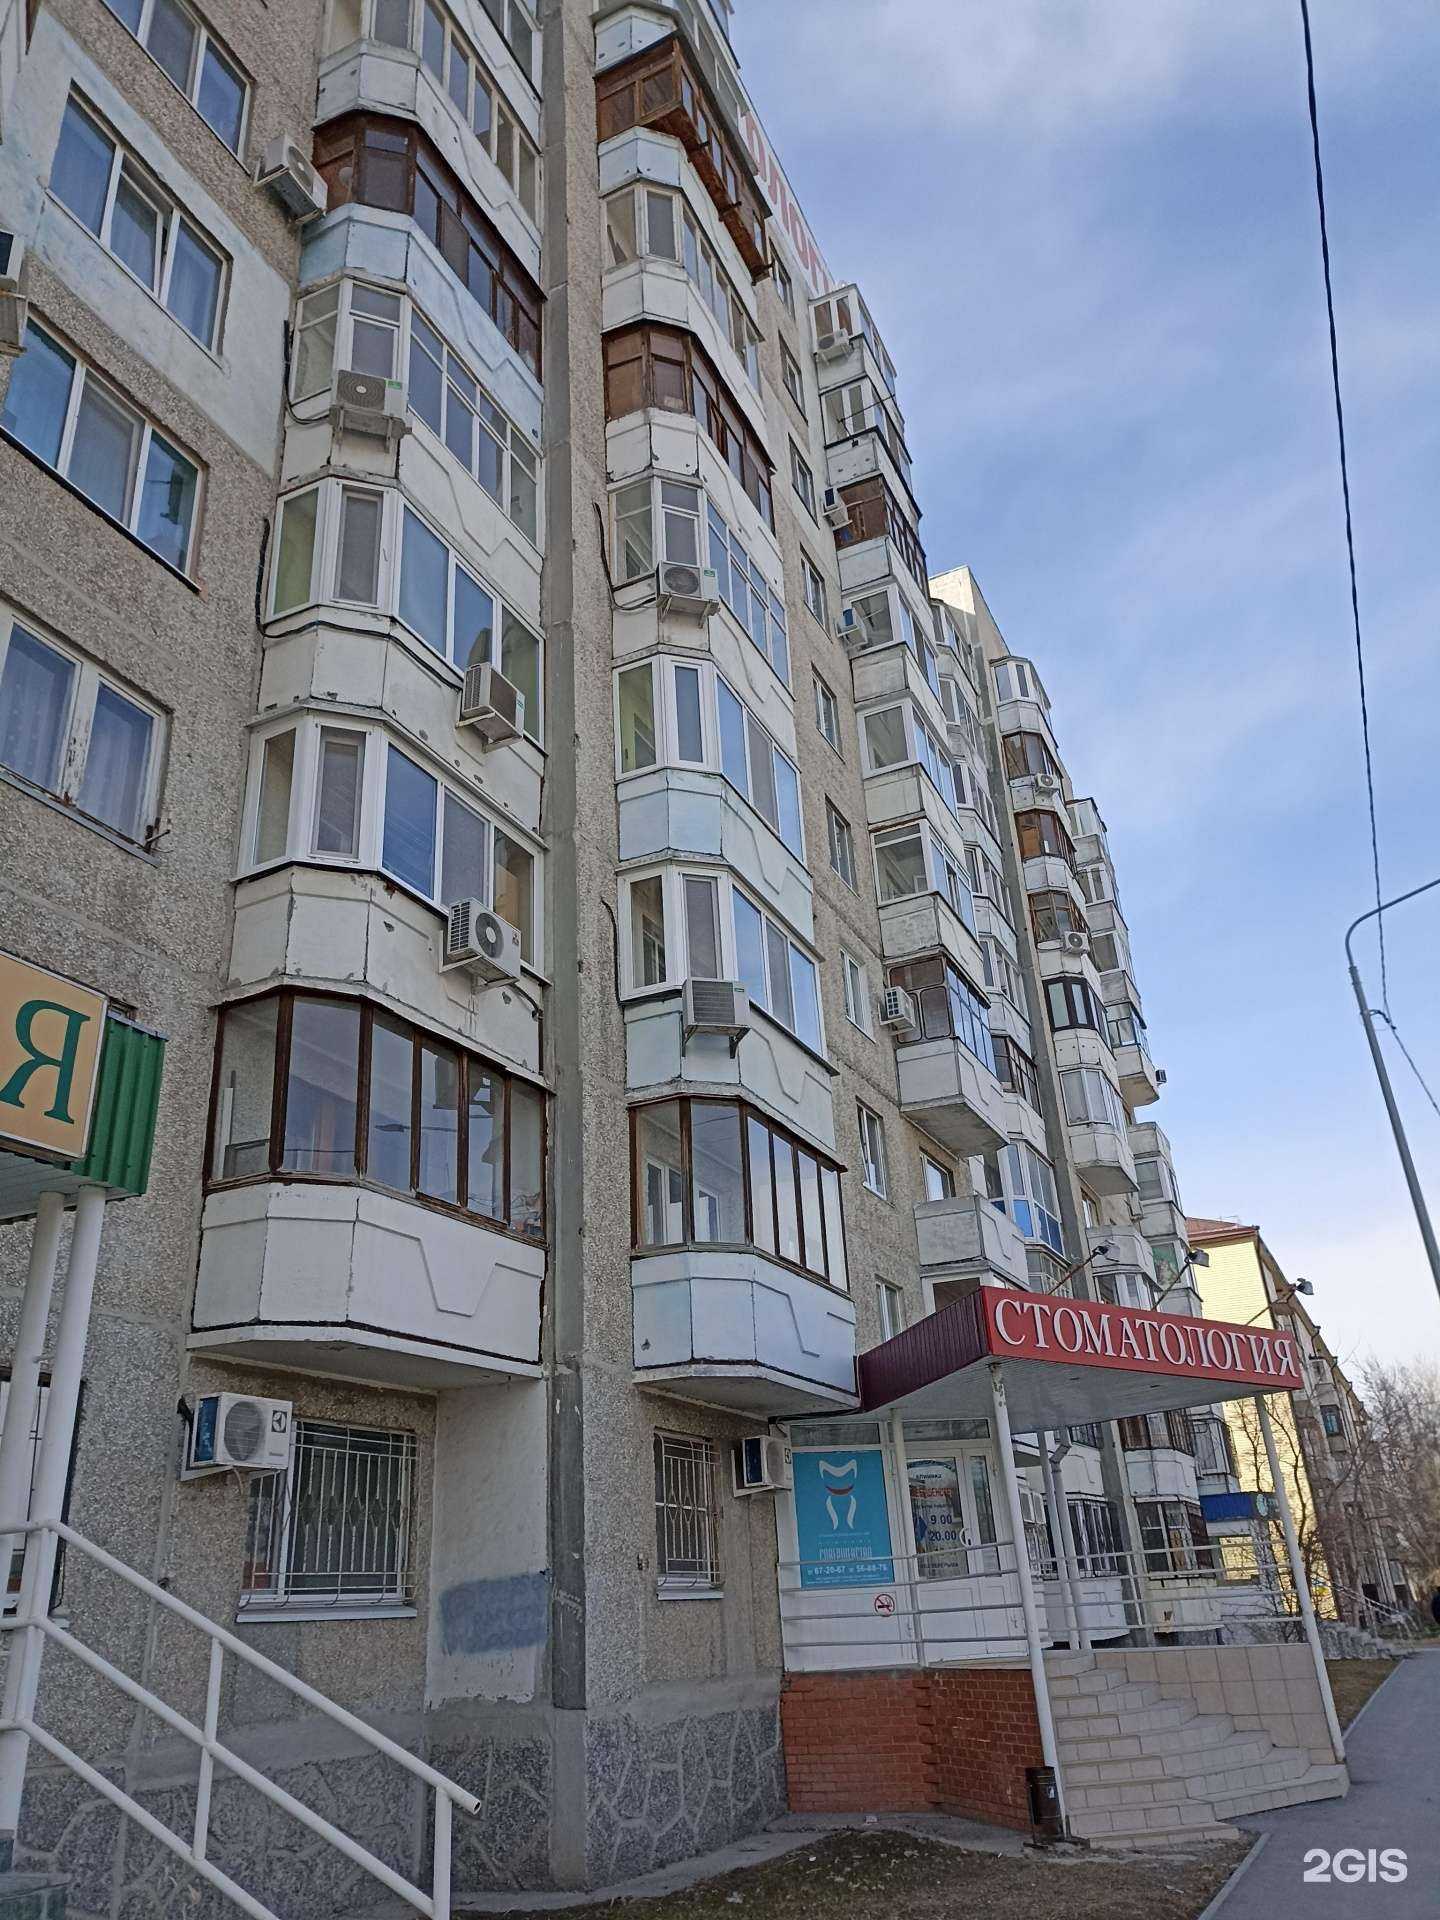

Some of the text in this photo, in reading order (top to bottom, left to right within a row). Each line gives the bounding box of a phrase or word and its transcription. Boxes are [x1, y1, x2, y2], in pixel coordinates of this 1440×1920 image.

[995, 1298, 1299, 1378] СТОМАТОЛОГИЯ
[930, 1514, 953, 1525] 9.00
[928, 1530, 957, 1541] 20.00
